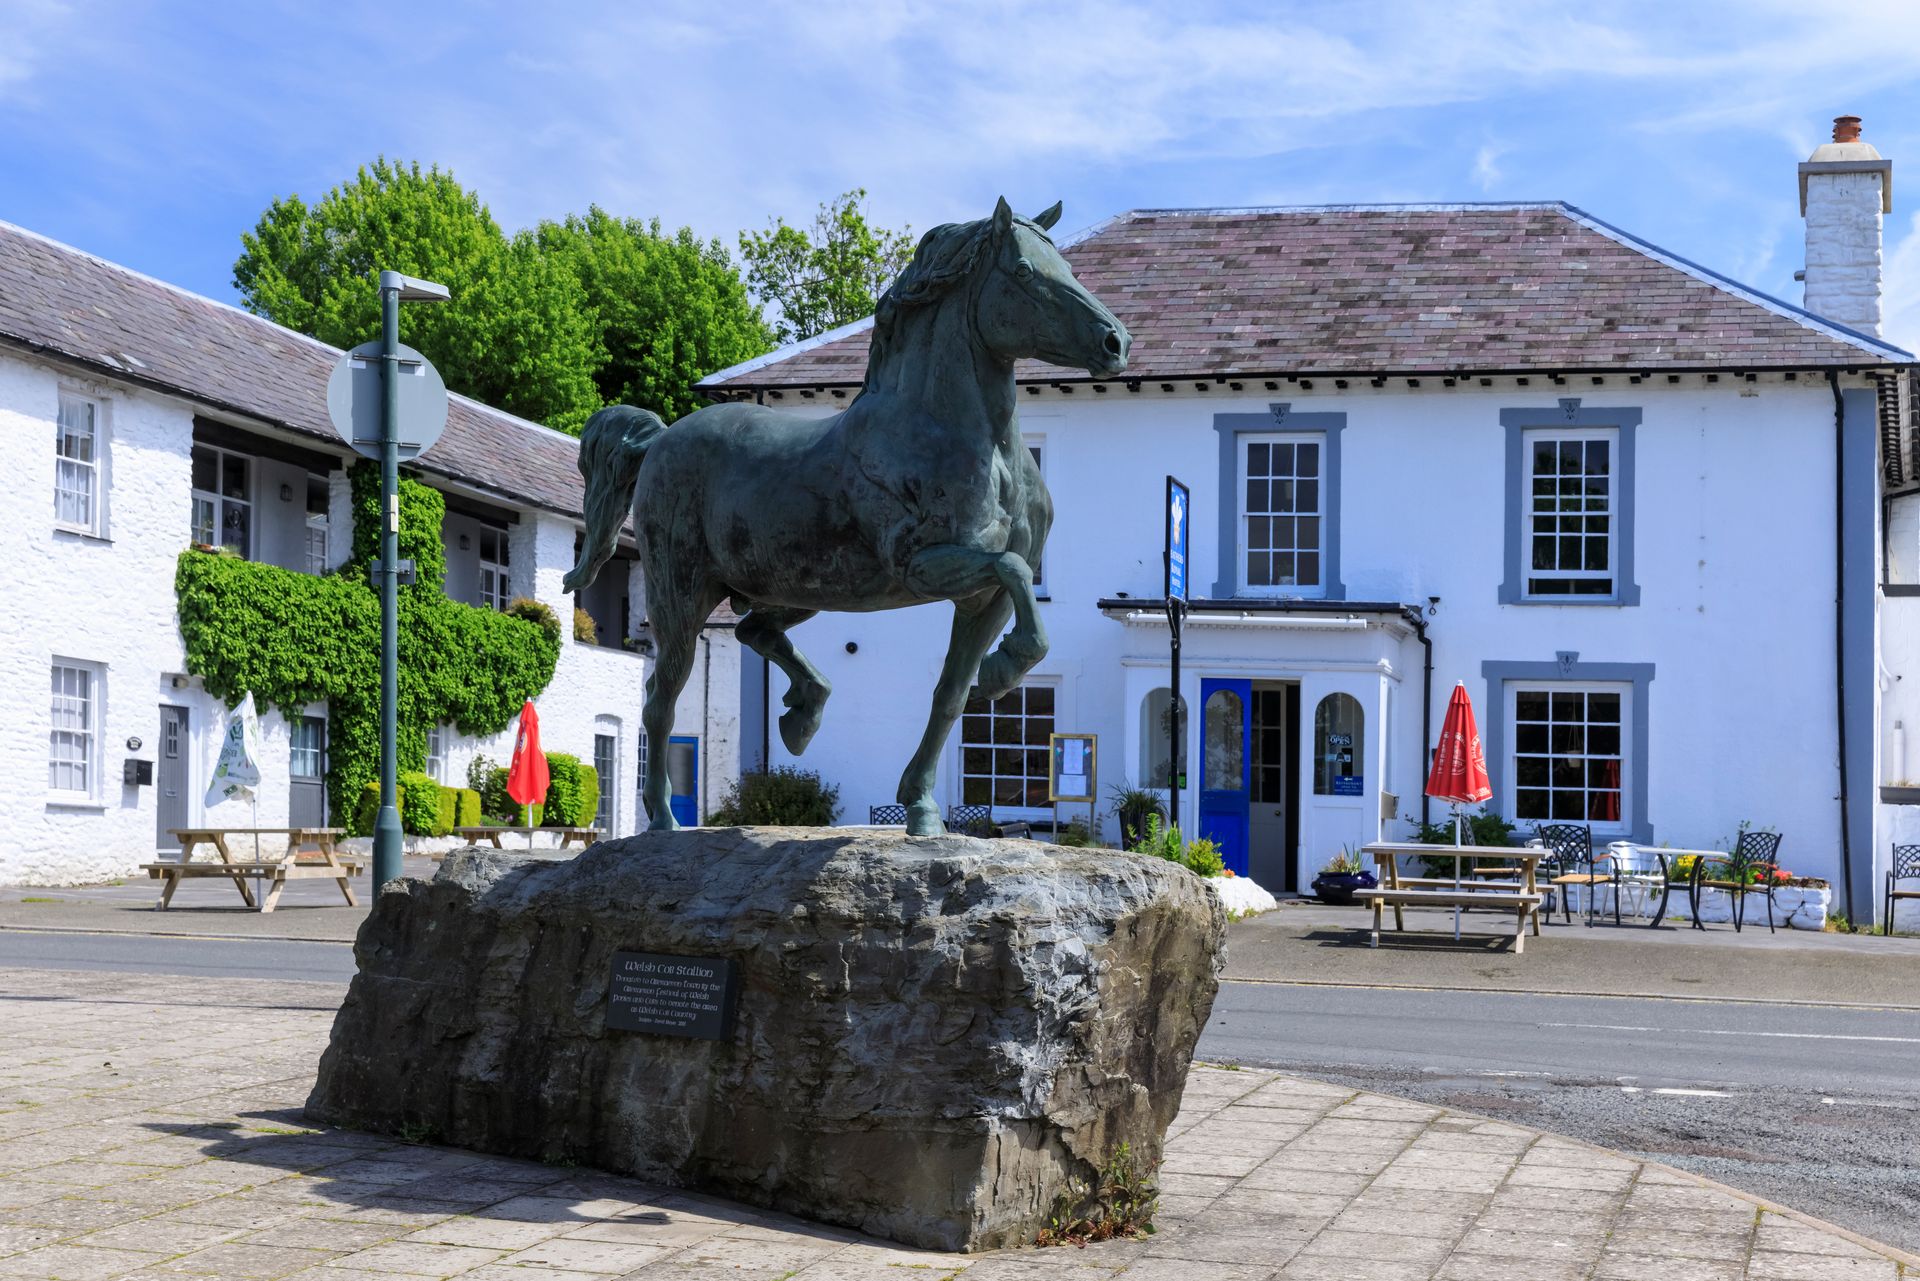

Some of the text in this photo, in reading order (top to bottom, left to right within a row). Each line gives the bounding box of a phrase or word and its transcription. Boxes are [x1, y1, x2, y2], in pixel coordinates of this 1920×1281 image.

[625, 961, 656, 973] Welsh
[676, 965, 714, 978] Stallion
[689, 991, 710, 1001] Welsh
